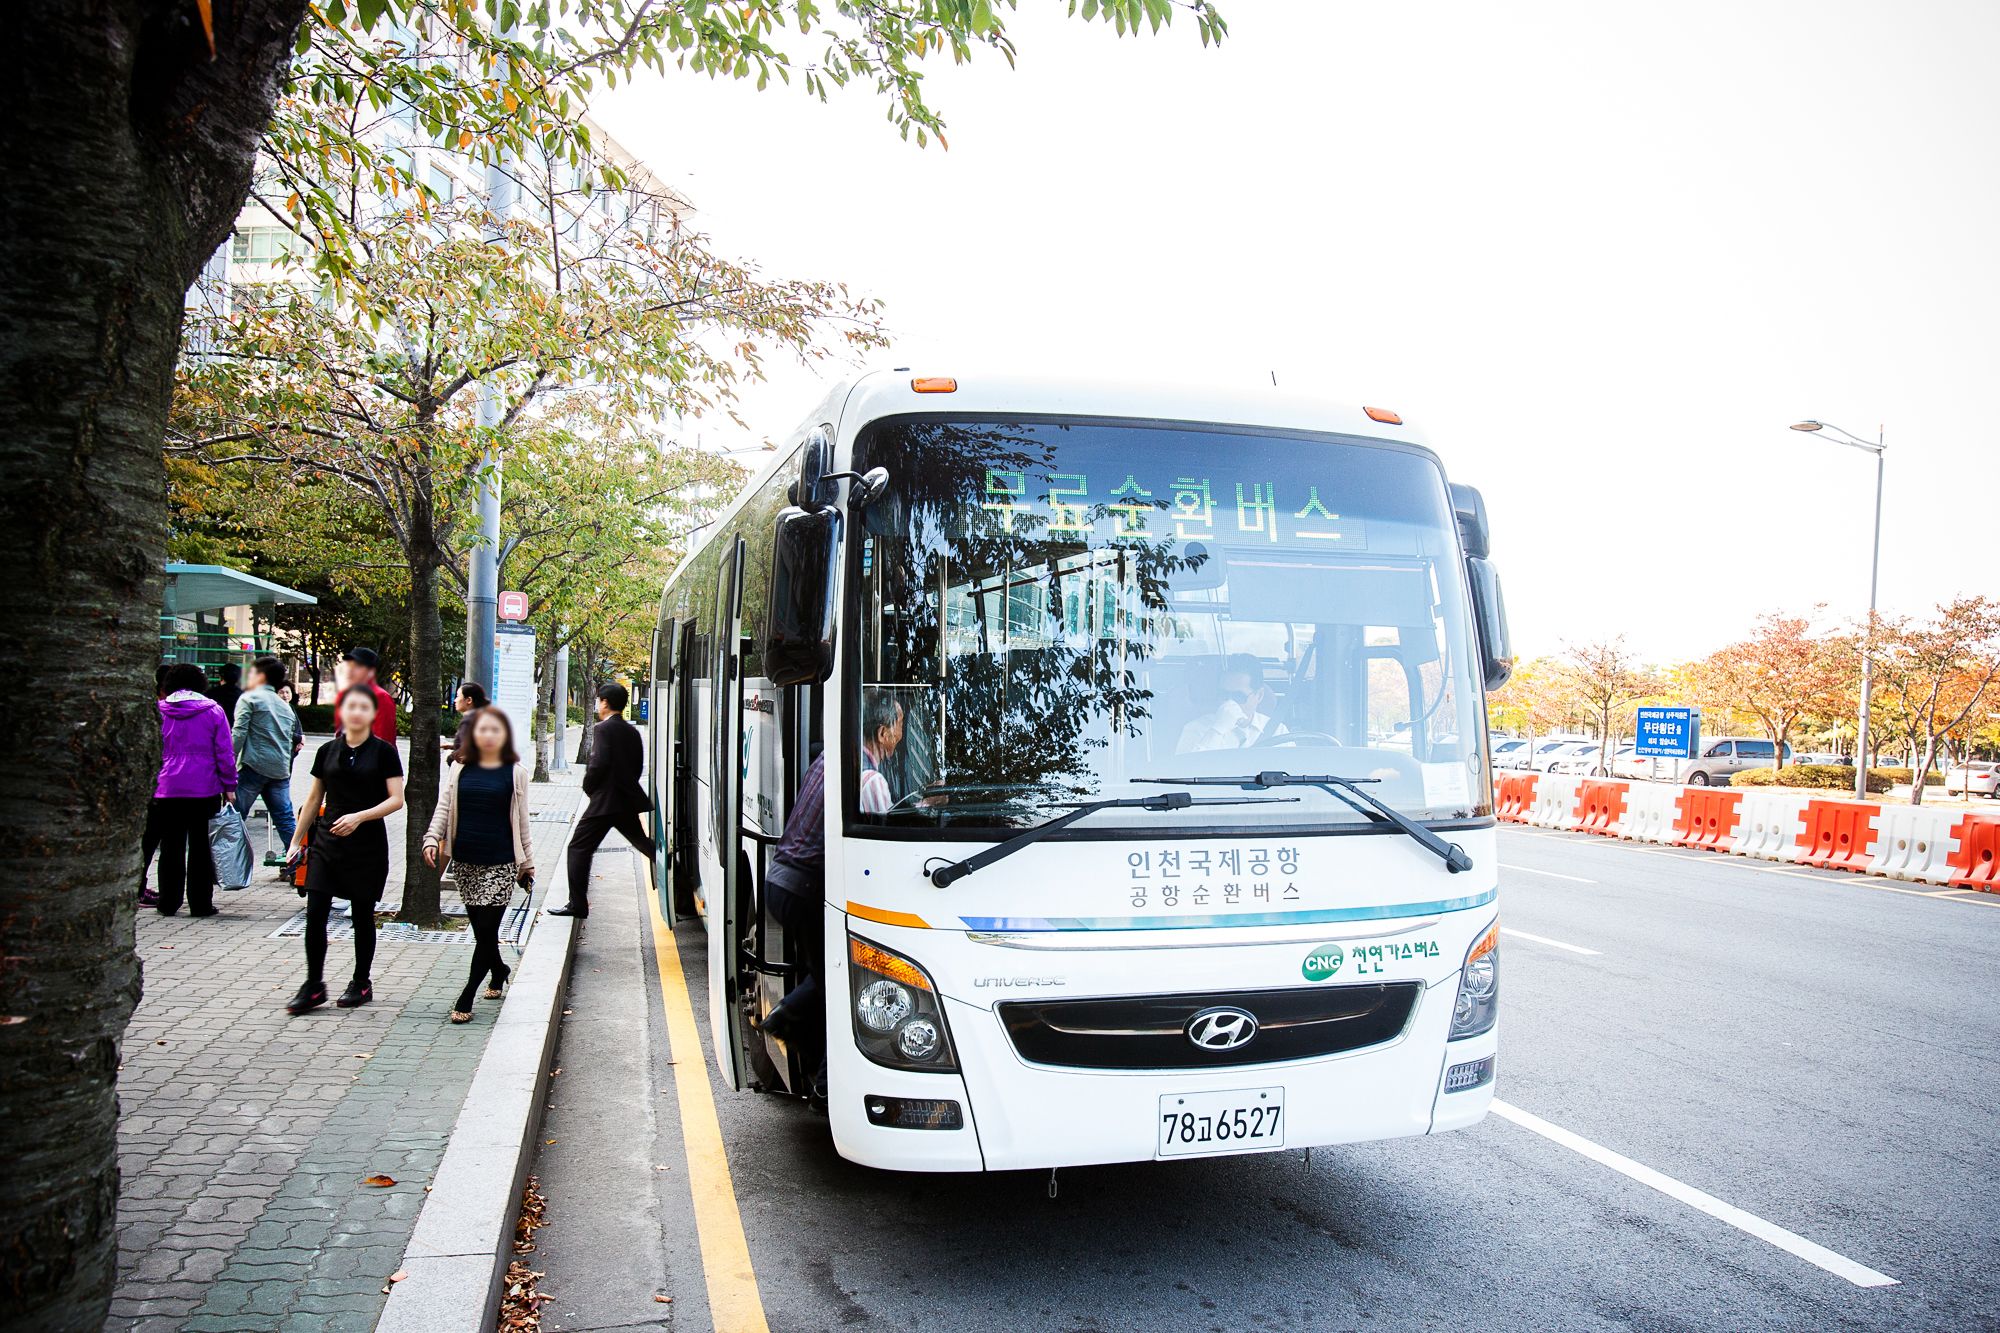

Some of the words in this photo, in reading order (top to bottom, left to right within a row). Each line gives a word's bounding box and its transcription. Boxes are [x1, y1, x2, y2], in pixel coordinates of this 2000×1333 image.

[982, 470, 1341, 543] 무료순환버스
[1127, 847, 1300, 879] 인천국제공항
[1305, 955, 1341, 971] CNG
[1352, 940, 1440, 974] 천연가스버스
[1163, 1106, 1281, 1145] 78고6527
